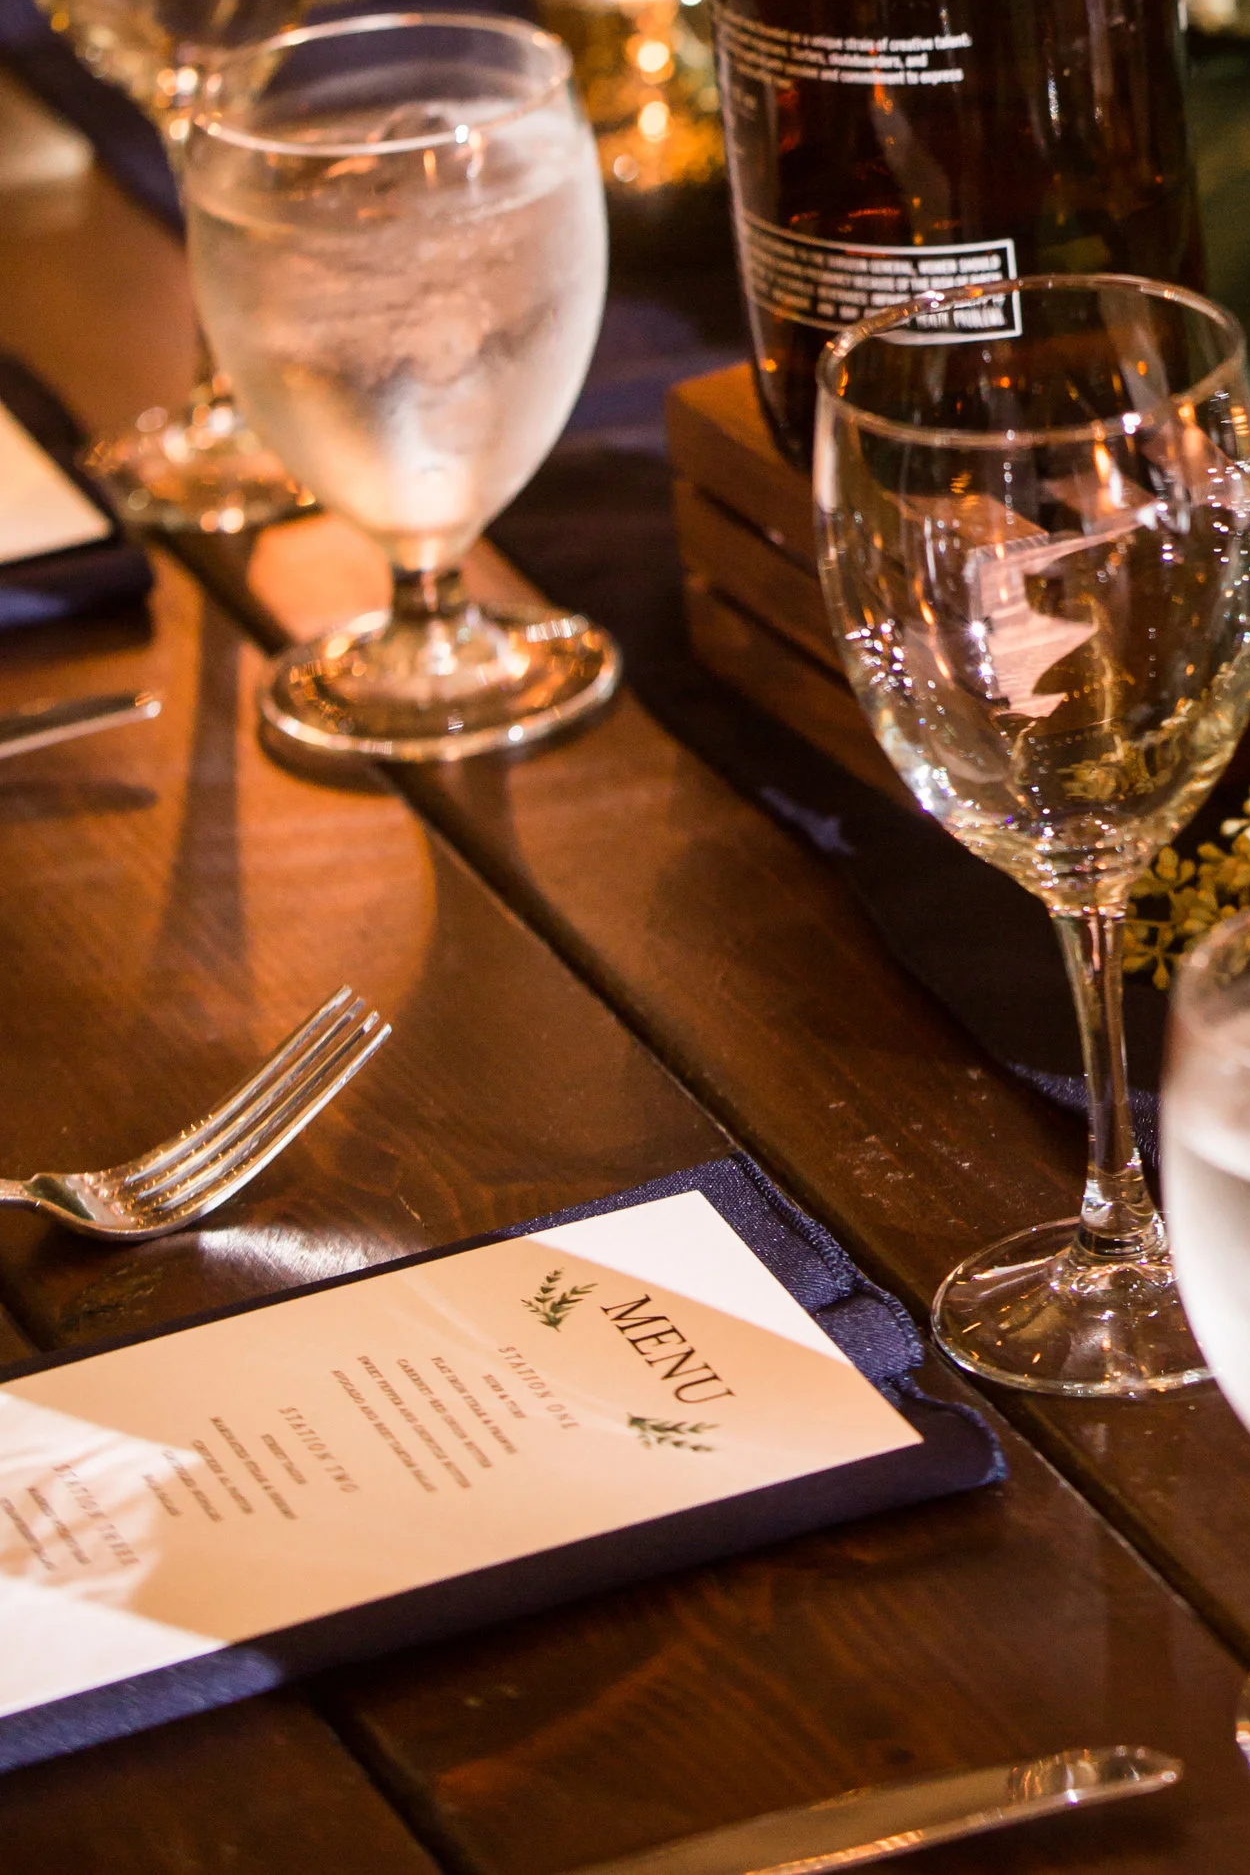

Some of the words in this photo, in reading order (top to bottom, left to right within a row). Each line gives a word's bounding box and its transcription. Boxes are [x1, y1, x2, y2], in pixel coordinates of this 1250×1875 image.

[498, 1346, 555, 1398] STATION
[545, 1403, 581, 1429] ONE
[601, 1294, 735, 1404] MENU
[278, 1407, 336, 1460] STATION
[324, 1465, 360, 1493] TWO
